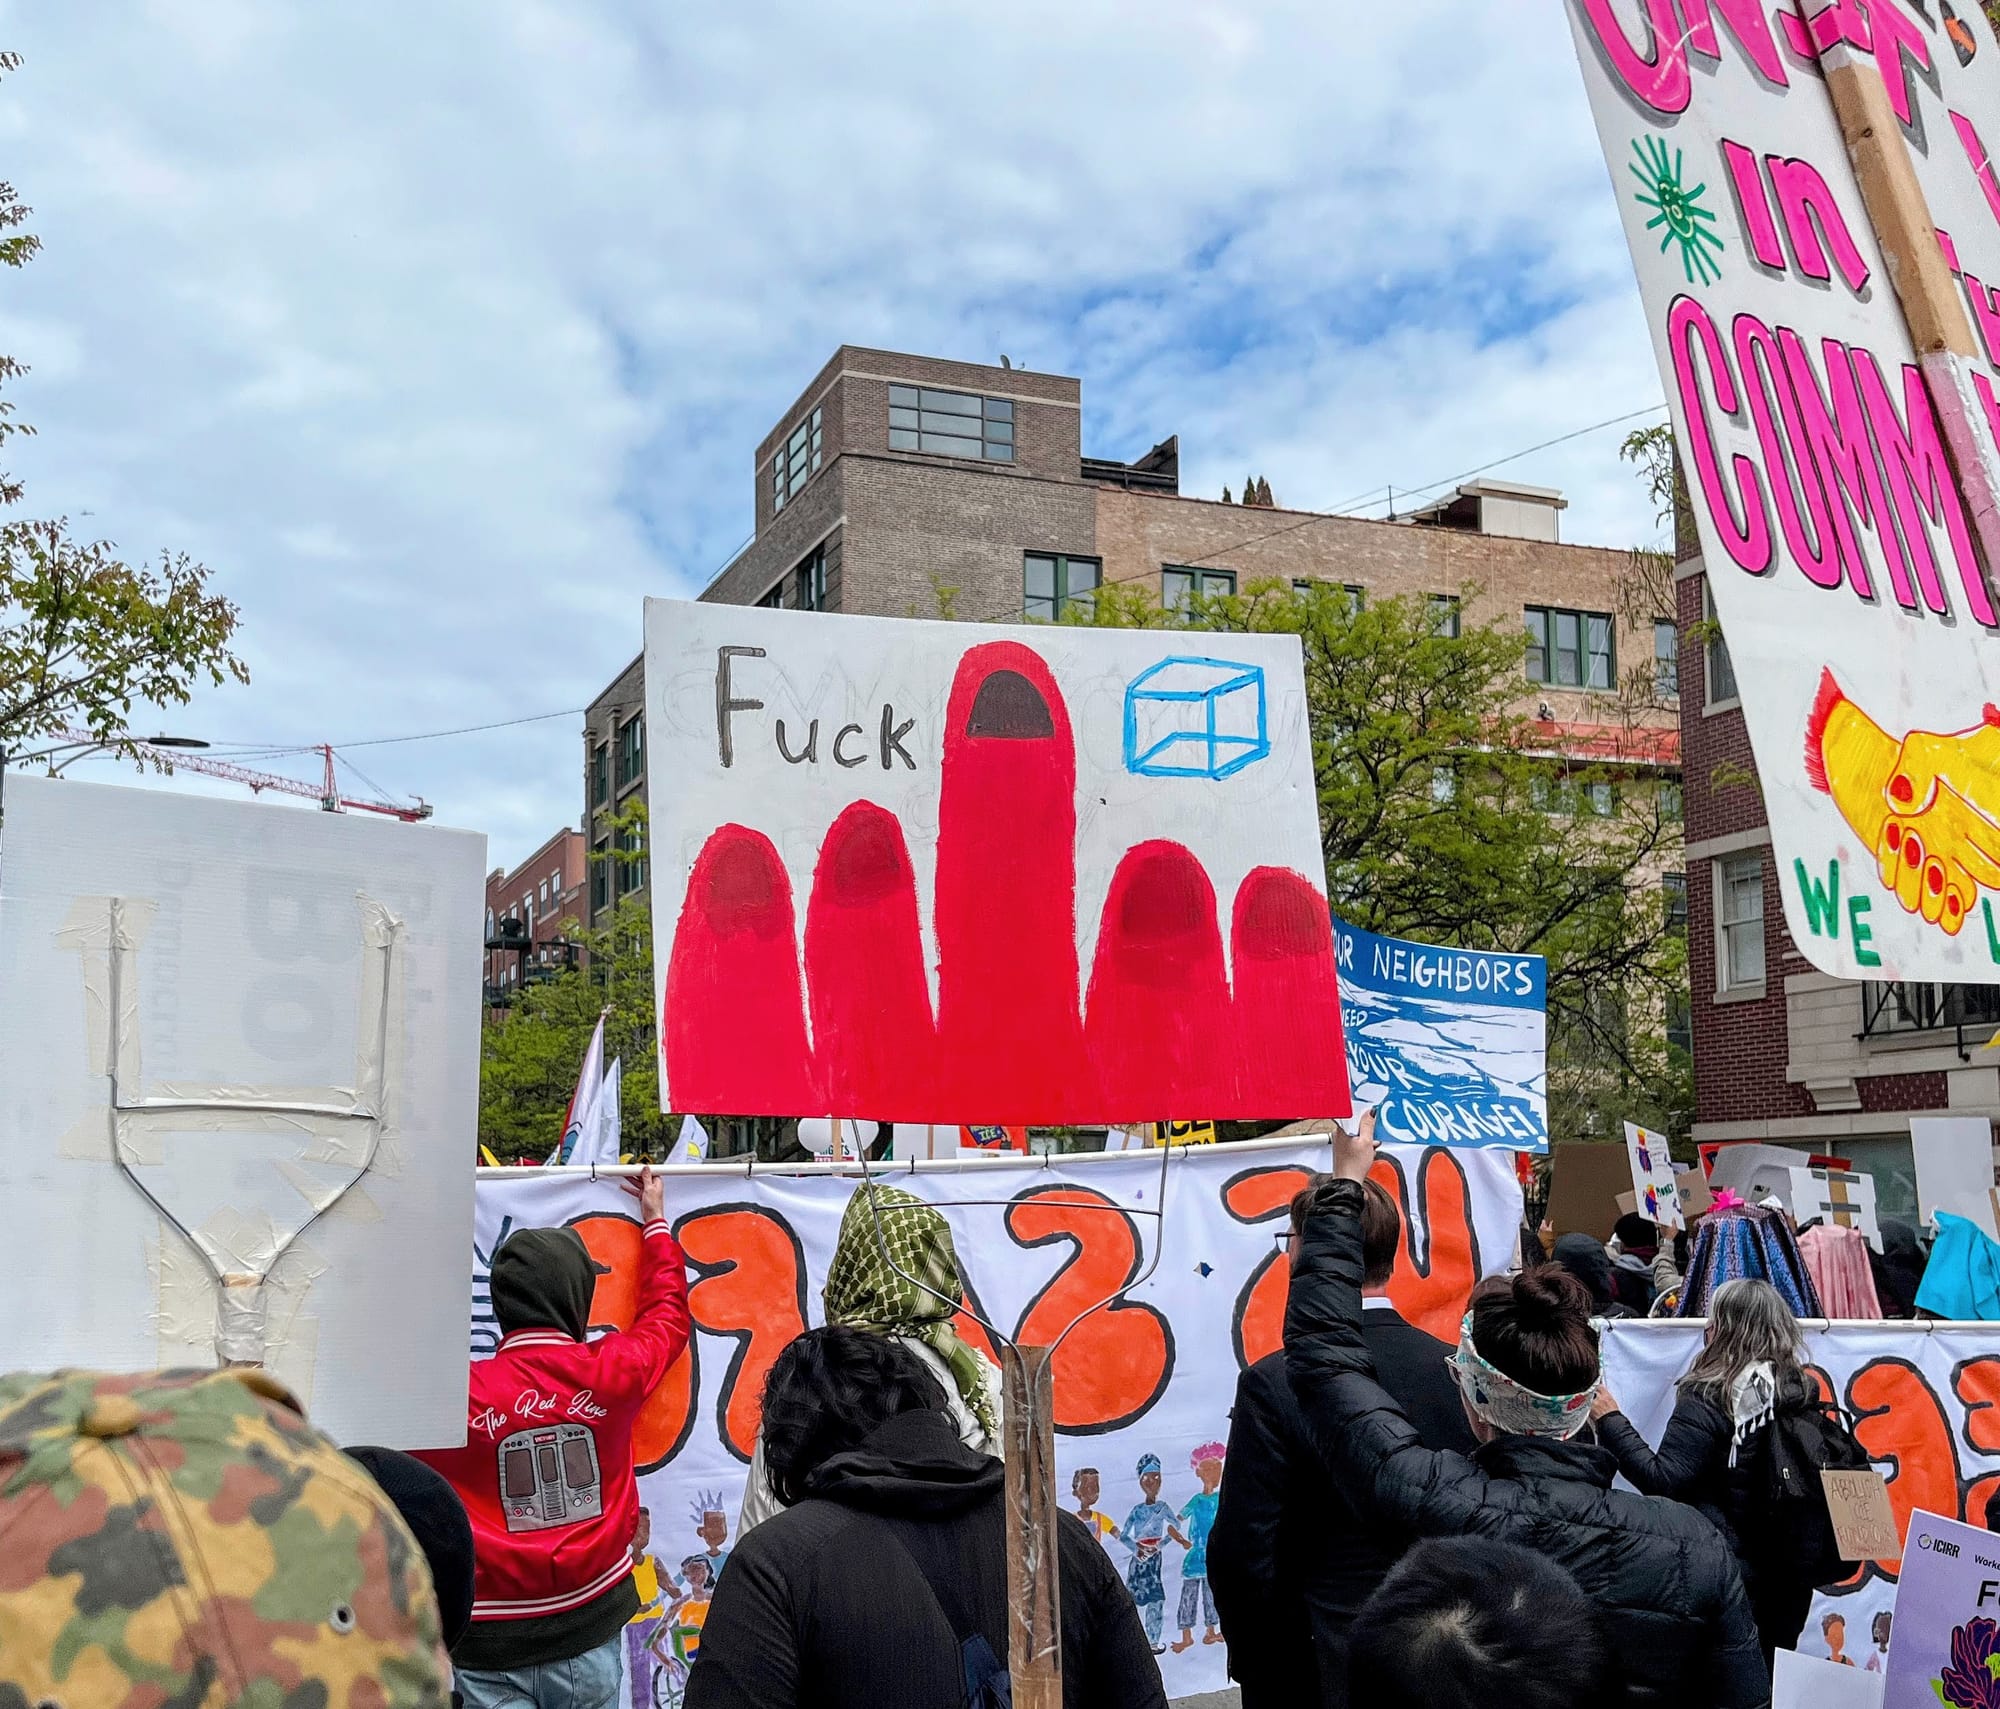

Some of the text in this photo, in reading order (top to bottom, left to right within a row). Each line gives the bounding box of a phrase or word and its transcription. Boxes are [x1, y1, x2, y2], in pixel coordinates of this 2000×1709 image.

[715, 646, 917, 769] Fuck
[1794, 856, 1881, 967] WE
[1331, 928, 1533, 996] OUR NEIGHBORS
[1346, 1041, 1434, 1090] YOUR
[1381, 1099, 1549, 1144] COURAGE!
[472, 1389, 608, 1440] The Red Line
[1933, 1539, 1960, 1558] ICIRR
